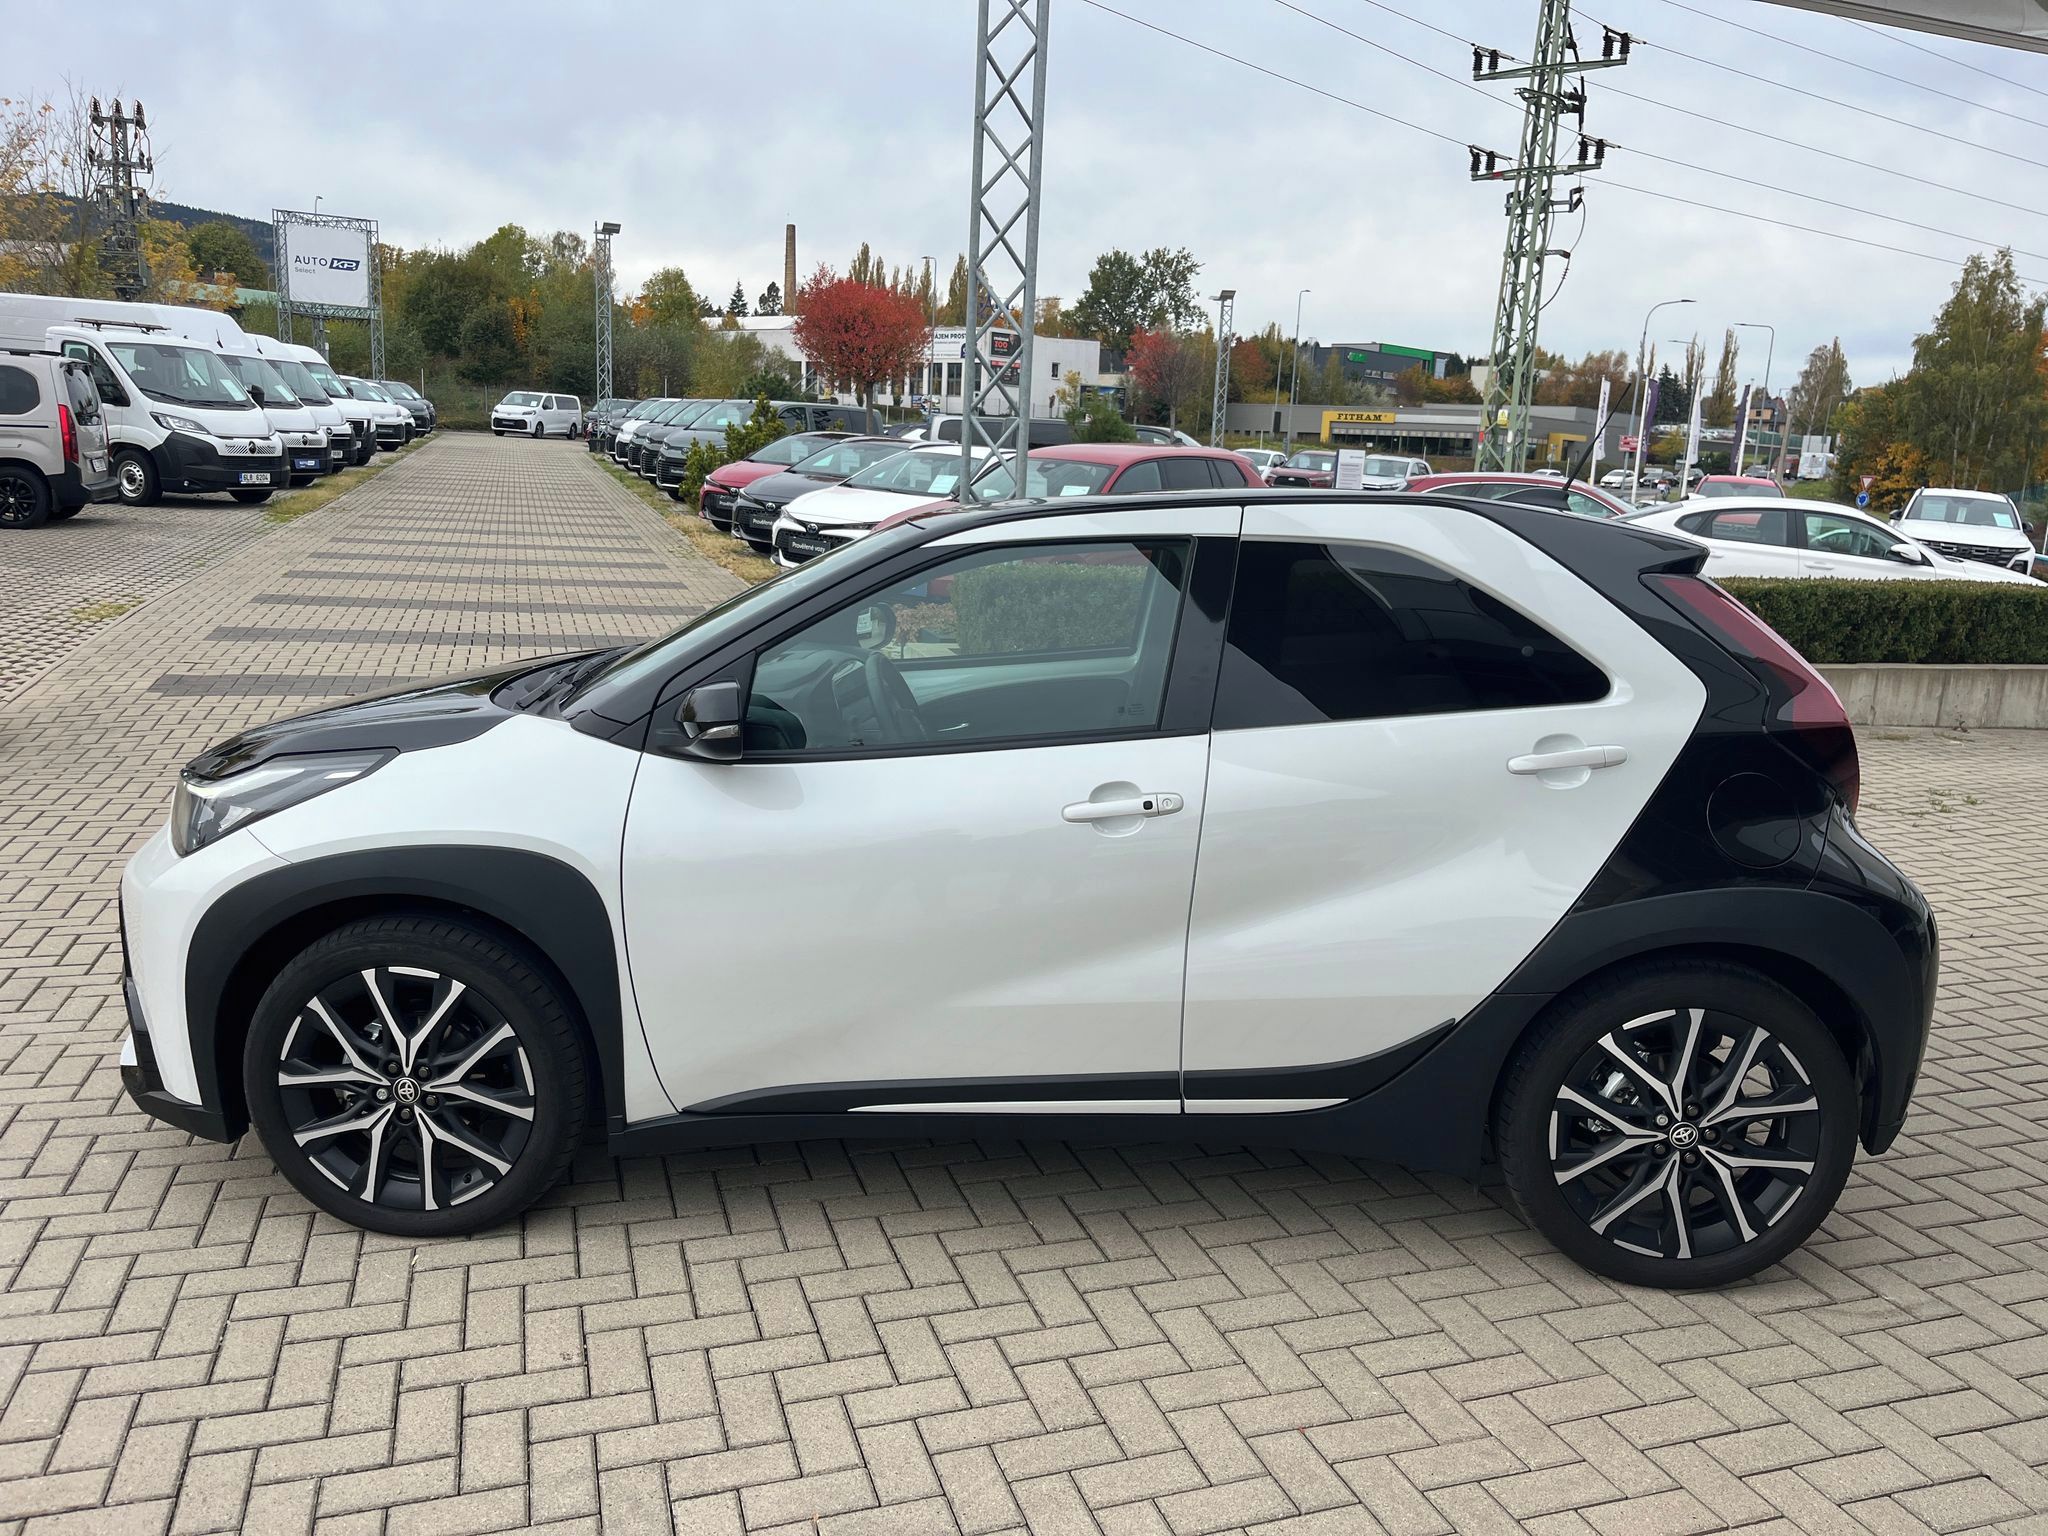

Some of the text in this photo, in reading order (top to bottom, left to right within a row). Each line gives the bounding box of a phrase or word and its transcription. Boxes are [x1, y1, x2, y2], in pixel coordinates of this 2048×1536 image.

[294, 255, 328, 267] AUTO
[294, 266, 316, 274] Select
[1337, 413, 1383, 422] FITHAM
